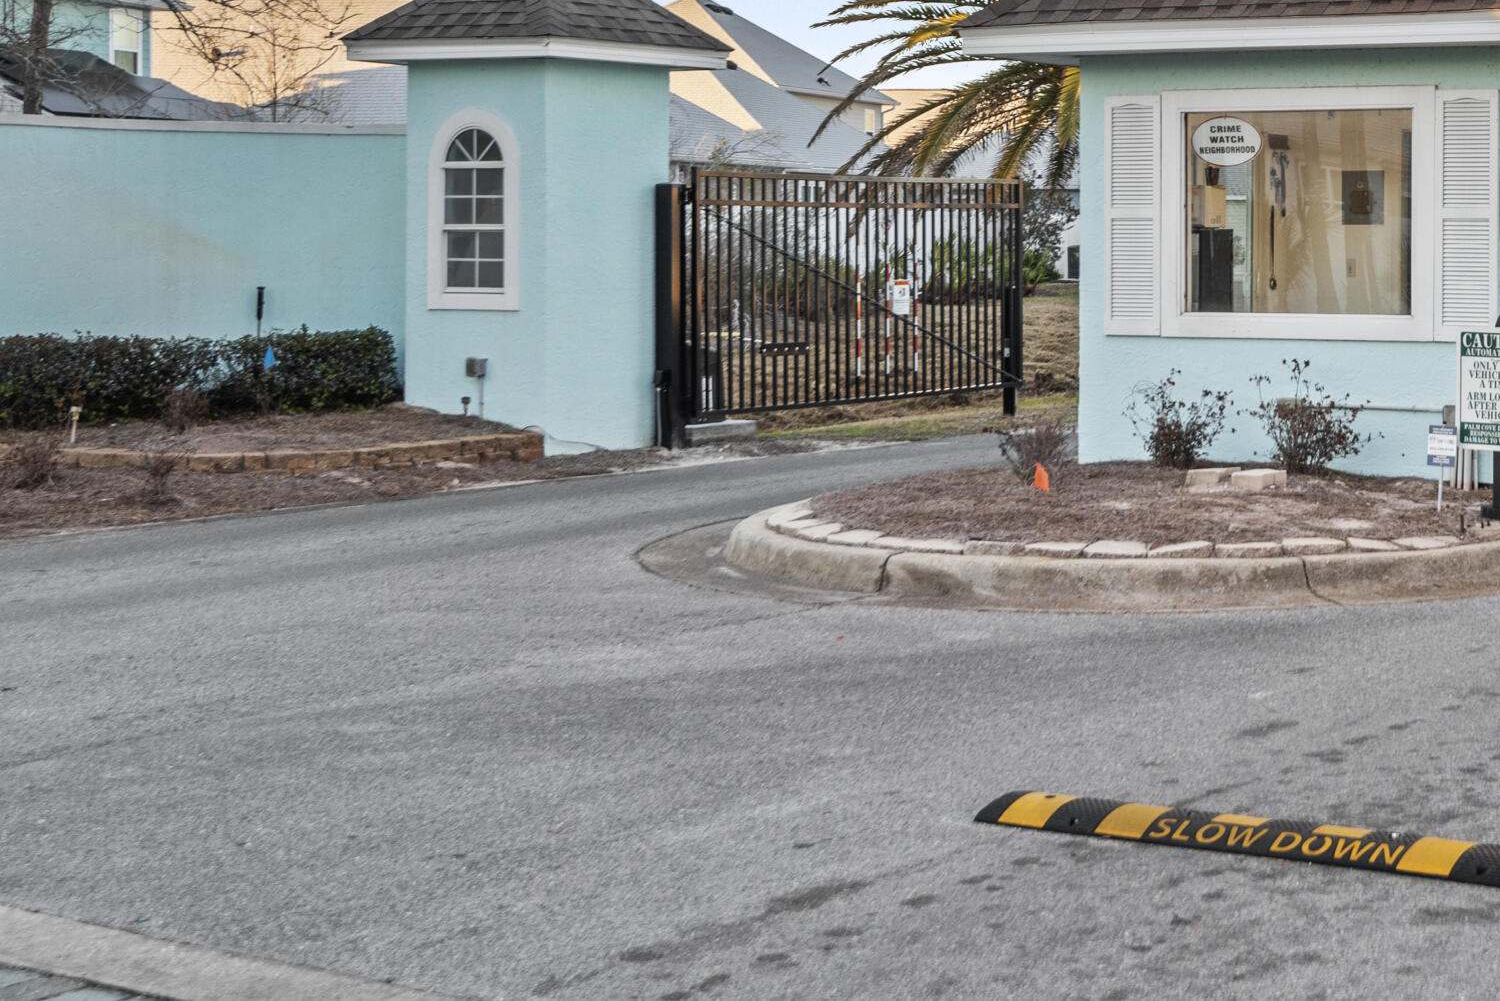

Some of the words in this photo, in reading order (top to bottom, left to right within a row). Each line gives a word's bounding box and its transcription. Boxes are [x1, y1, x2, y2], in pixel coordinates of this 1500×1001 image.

[1210, 125, 1241, 133] CRIME
[1209, 136, 1244, 144] WATCH
[1200, 146, 1256, 154] NEIGHBORHOOD
[1474, 360, 1498, 370] ONLY
[1480, 380, 1486, 388] A
[1467, 392, 1486, 400] ARM
[1468, 400, 1497, 410] AFTER
[1464, 436, 1488, 444] DAMAGE
[1149, 818, 1269, 848] SLOW
[1269, 831, 1405, 866] DOWN
